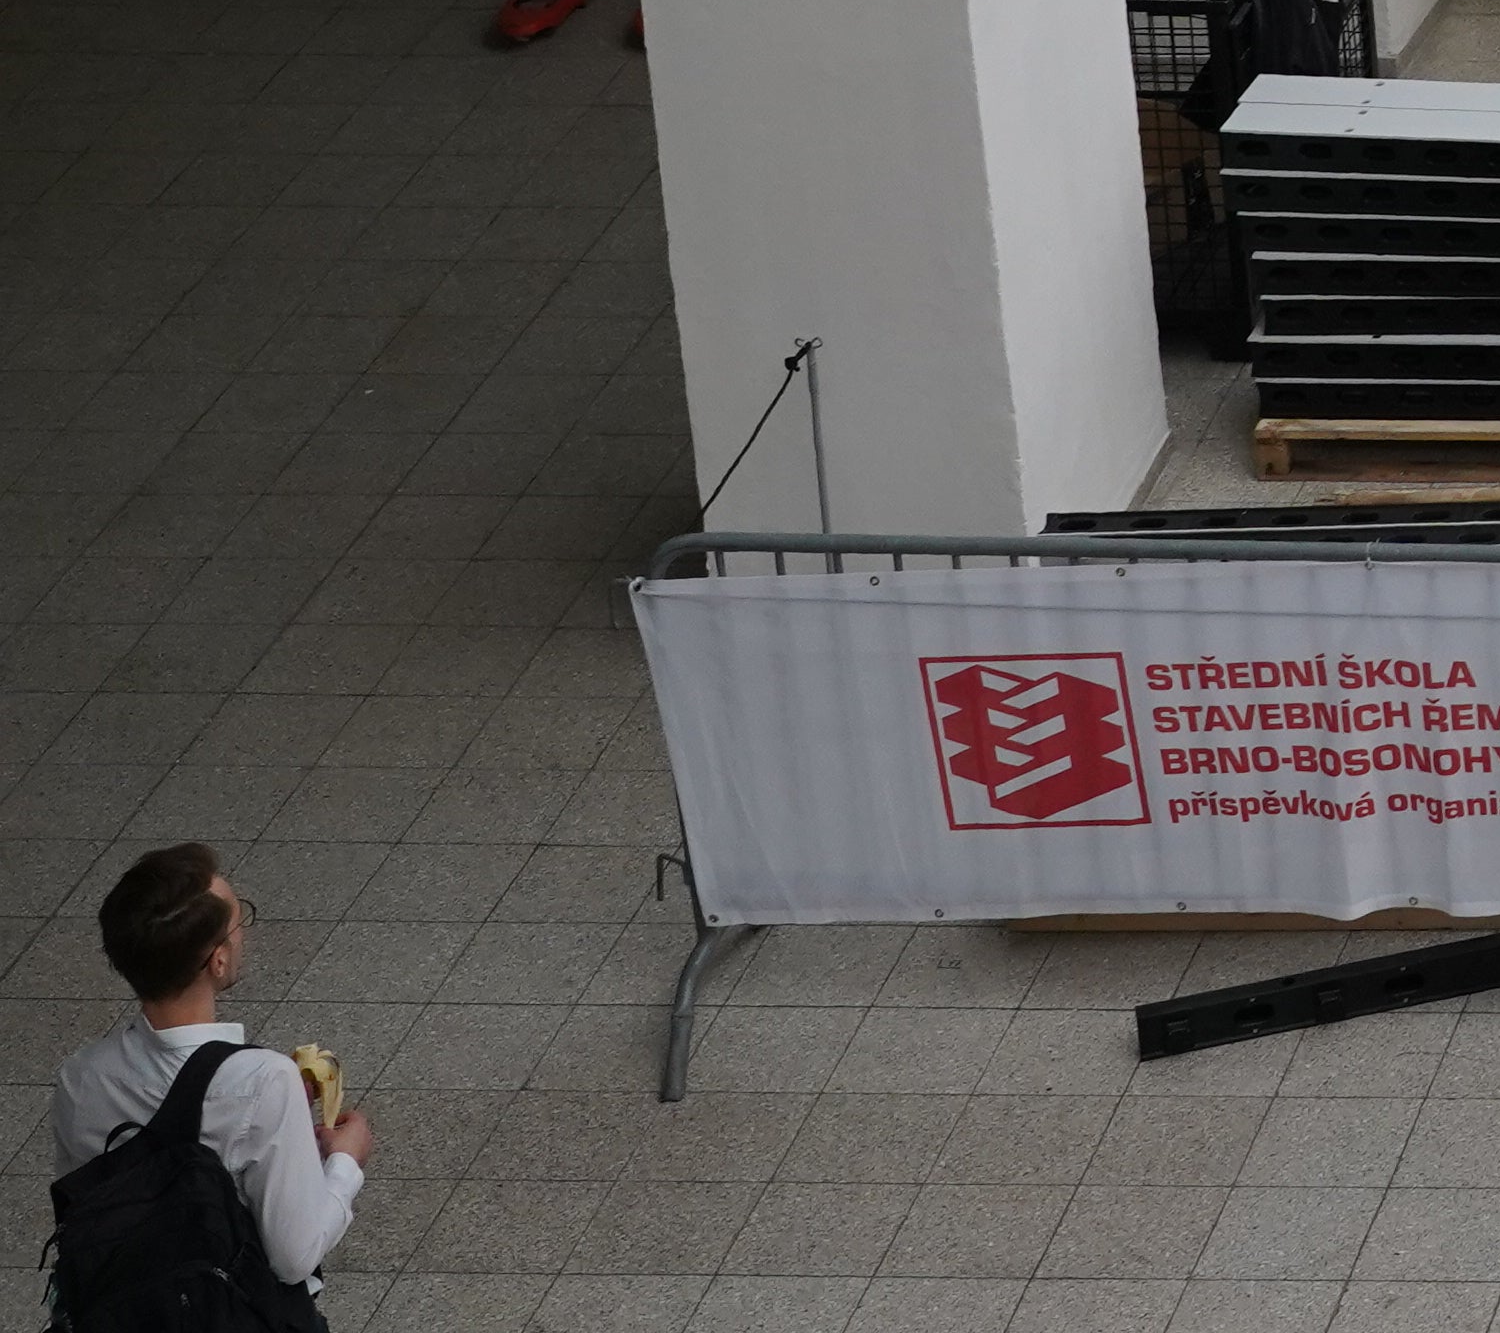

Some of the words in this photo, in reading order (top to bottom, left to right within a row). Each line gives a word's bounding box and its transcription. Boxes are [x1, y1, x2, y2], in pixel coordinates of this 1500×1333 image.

[1144, 652, 1329, 692] STŘEDNÍ
[1337, 652, 1478, 690] ŠKOLA
[1151, 698, 1412, 734] STAVEBNÍCH
[1167, 788, 1376, 824] příspěvková
